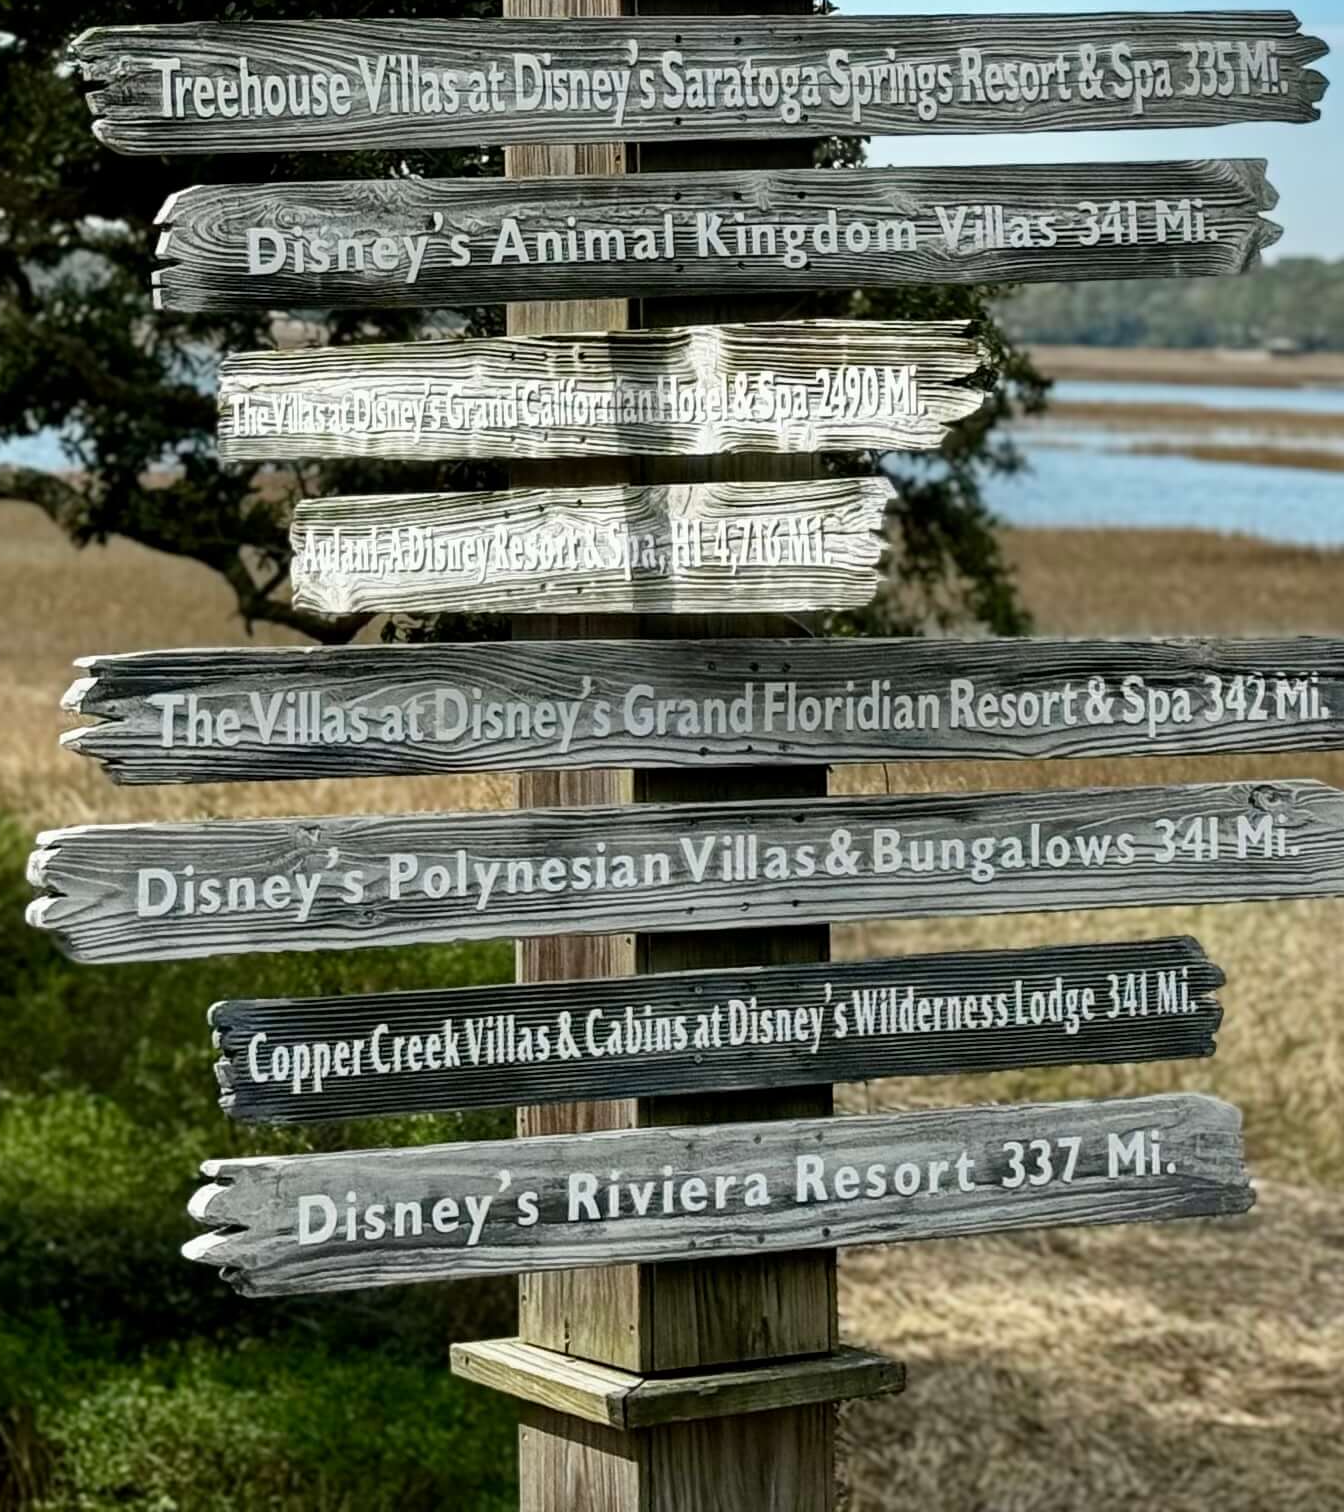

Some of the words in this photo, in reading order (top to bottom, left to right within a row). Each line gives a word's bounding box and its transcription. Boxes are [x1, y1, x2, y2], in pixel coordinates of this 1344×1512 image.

[153, 57, 353, 119] Treehouse
[358, 54, 457, 114] Villas
[466, 61, 506, 112] at
[512, 39, 654, 126] Disney's
[661, 51, 822, 124] Saratoga
[826, 48, 953, 123] Springs
[959, 46, 1072, 105] Resort
[1078, 44, 1109, 98] &
[1110, 42, 1172, 115] Spa
[1181, 42, 1238, 97] 335
[1240, 40, 1289, 96] Mi.
[247, 212, 471, 284] Disney's
[490, 214, 674, 265] Animal
[695, 212, 917, 269] Kingdom
[934, 205, 1056, 250] Villas
[1077, 200, 1137, 245] 341
[1156, 197, 1219, 244] Mi.
[229, 394, 268, 437] The
[272, 392, 325, 434] Villas
[325, 392, 353, 433] at
[354, 382, 441, 443] Disney's
[446, 382, 517, 428] Grand
[524, 376, 656, 426] Californian
[658, 373, 727, 424] Hotel
[735, 371, 755, 421] &
[755, 370, 808, 433] Spa
[816, 367, 878, 420] 2490
[885, 365, 925, 417] Mi.
[304, 526, 387, 578] Aulani,
[388, 527, 406, 571] A
[406, 526, 490, 584] Disney
[495, 524, 579, 570] Resort
[582, 524, 605, 568] &
[607, 522, 666, 580] Spa,
[672, 519, 702, 567] HI
[155, 695, 242, 748] The
[249, 691, 369, 746] Villas
[381, 701, 425, 743] at
[435, 676, 610, 753] Disney's
[623, 683, 753, 734] Grand
[763, 680, 940, 733] Floridian
[950, 679, 1077, 730] Resort
[1084, 675, 1114, 725] &
[1120, 674, 1192, 738] Spa
[1204, 672, 1268, 722] 342
[1276, 671, 1329, 719] Mi.
[138, 847, 364, 923] Disney's
[389, 842, 671, 911] Polynesian
[680, 832, 815, 882] Villas
[825, 829, 860, 876] &
[872, 824, 1135, 883] Bungalows
[1154, 817, 1217, 863] 341
[1237, 813, 1299, 858] Mi.
[247, 1032, 365, 1094] Copper
[370, 1019, 461, 1081] Creek
[464, 1015, 551, 1065] Villas
[557, 1010, 581, 1059] &
[585, 1005, 688, 1057] Cabins
[694, 1005, 722, 1049] at
[729, 983, 847, 1052] Disney's
[853, 987, 1008, 1037] Wilderness
[1015, 978, 1095, 1035] Lodge
[1106, 971, 1147, 1018] 341
[1158, 967, 1198, 1016] Mi.
[298, 1169, 540, 1245] Disney's
[567, 1166, 769, 1222] Riviera
[796, 1149, 976, 1203] Resort
[1001, 1136, 1083, 1188] 337
[1108, 1131, 1177, 1178] Mi.
